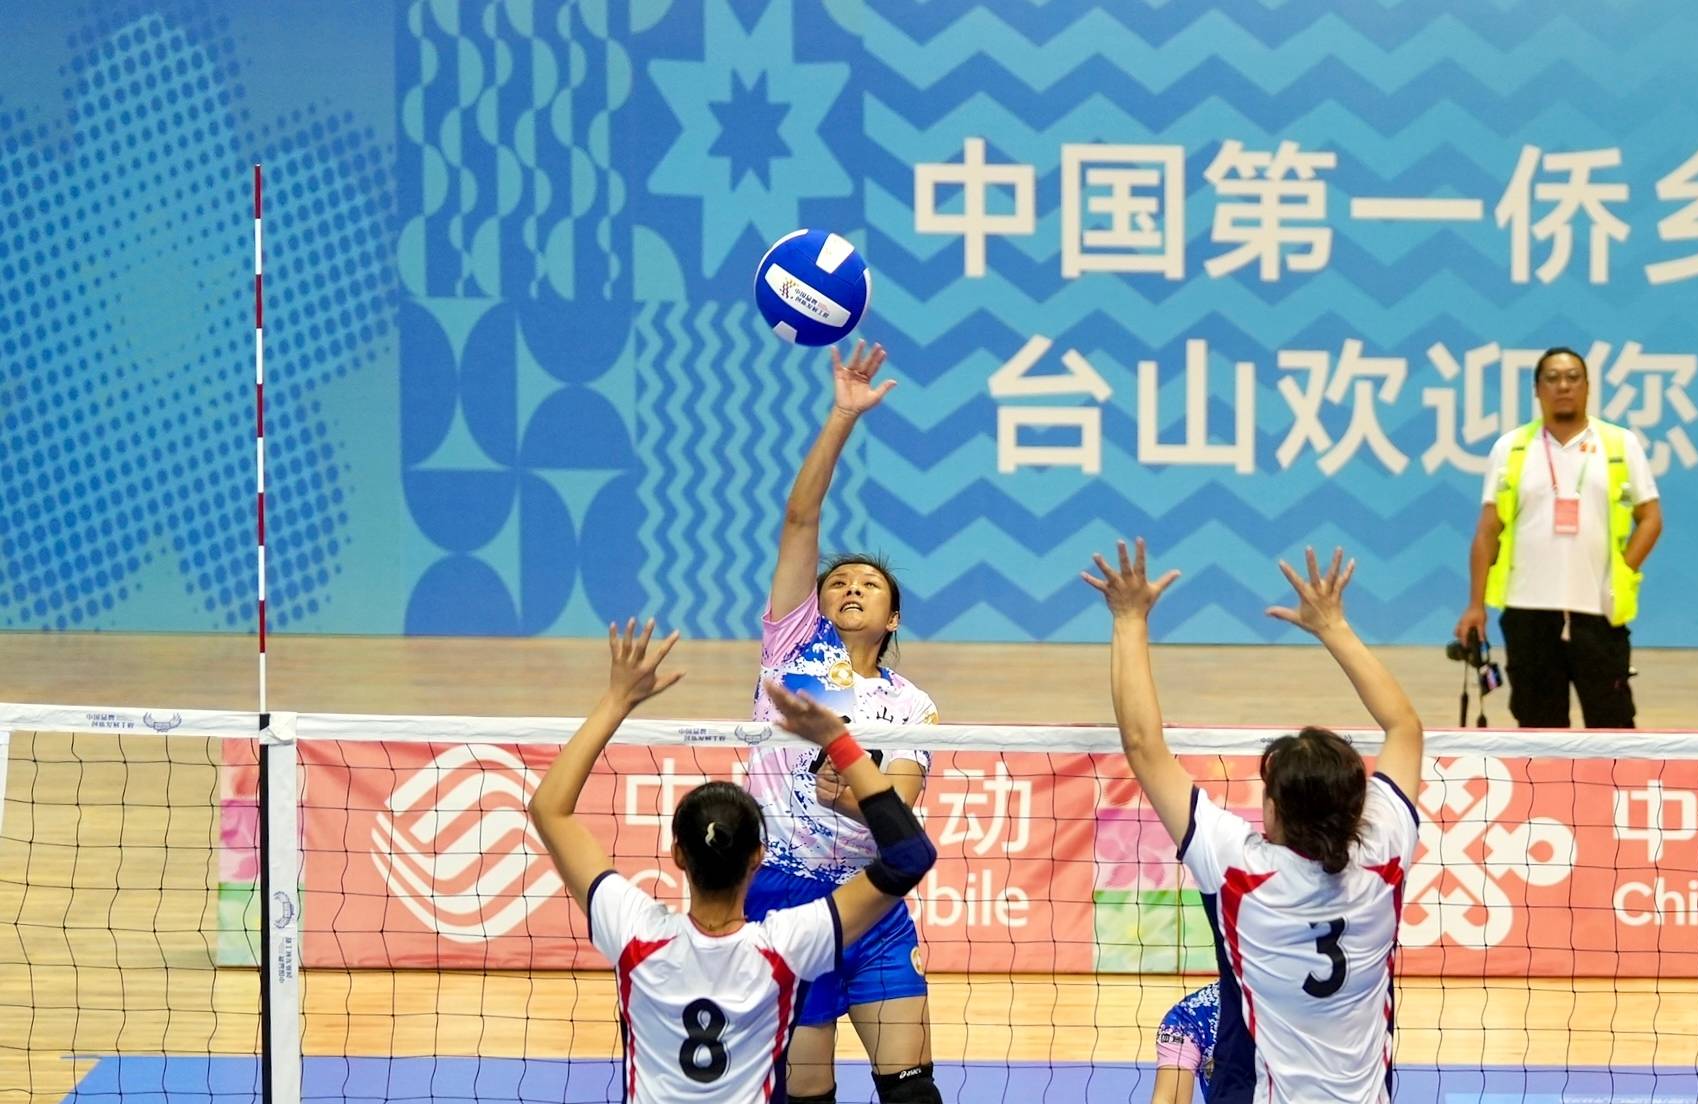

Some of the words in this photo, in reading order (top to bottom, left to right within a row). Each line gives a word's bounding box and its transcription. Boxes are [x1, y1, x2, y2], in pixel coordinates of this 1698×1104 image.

[625, 757, 1032, 856] 中动
[1303, 917, 1347, 999] 3
[679, 998, 729, 1083] 8
